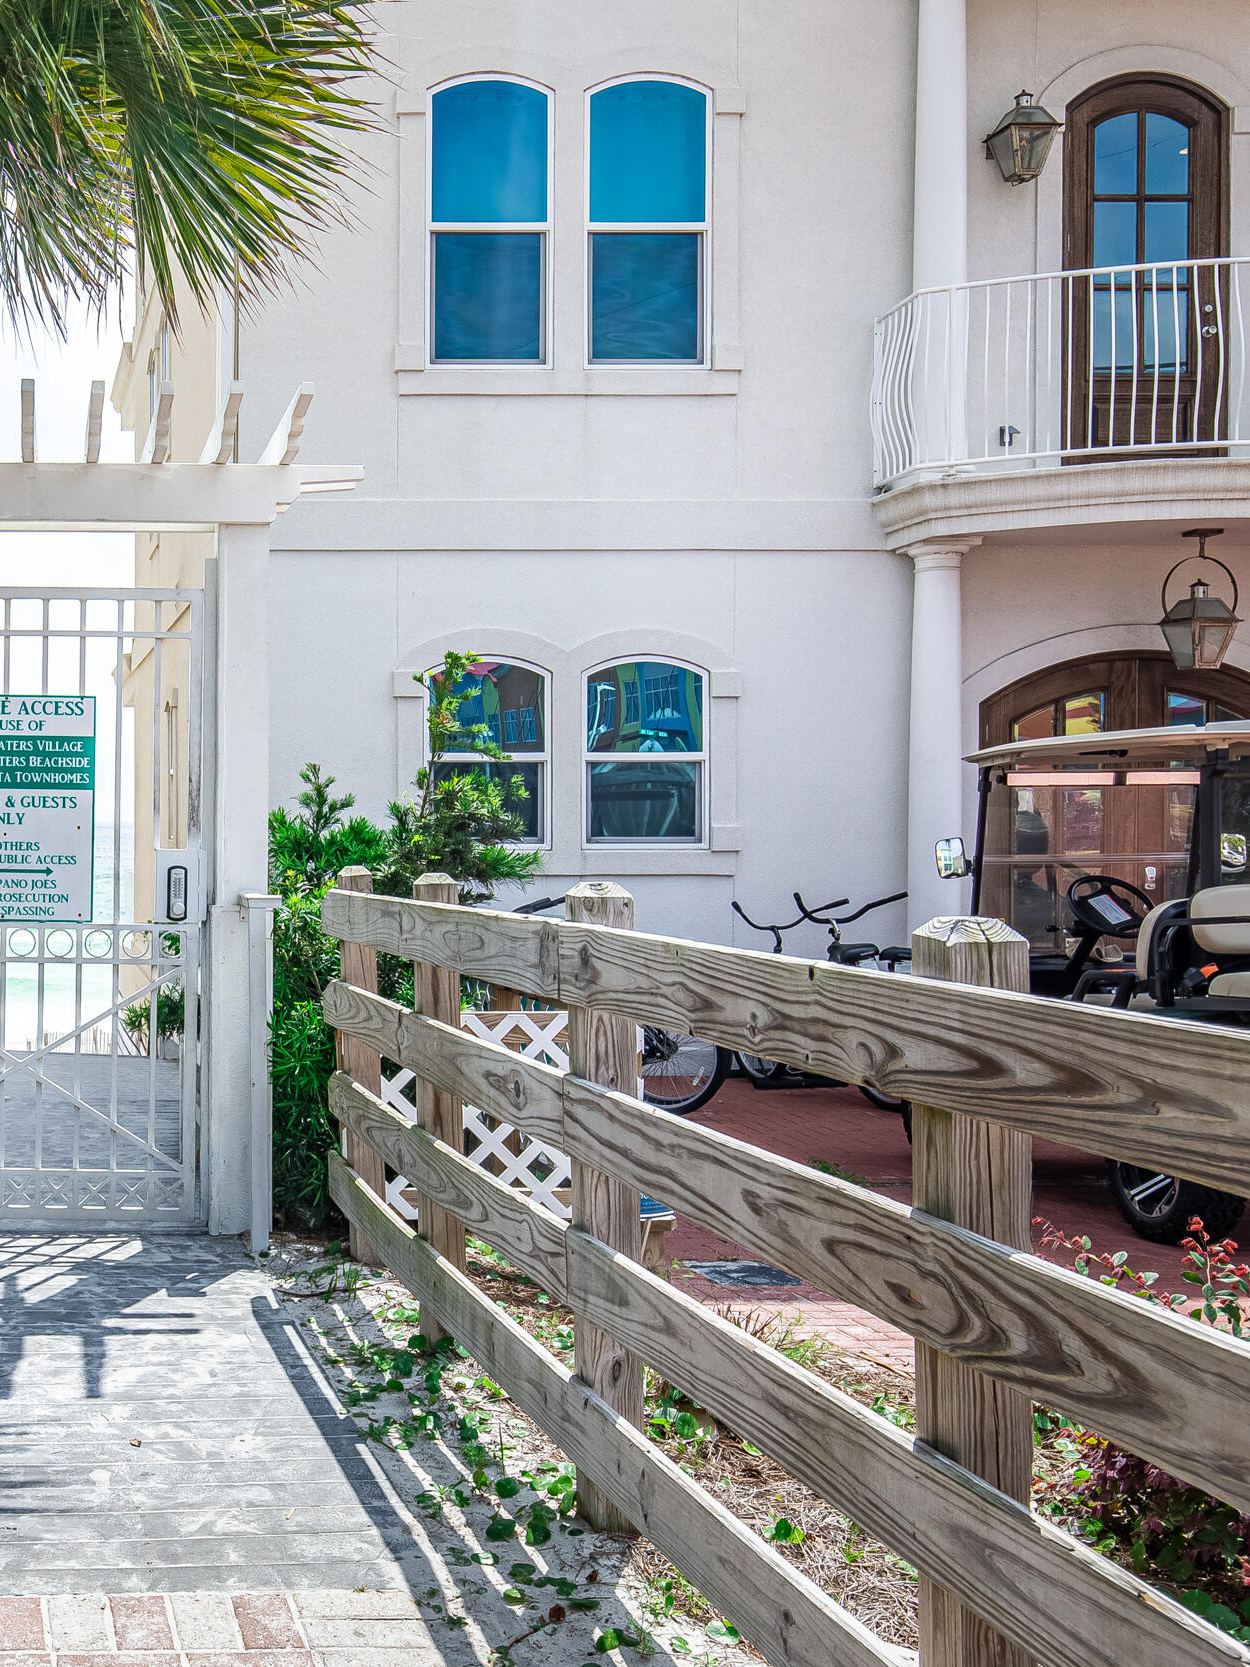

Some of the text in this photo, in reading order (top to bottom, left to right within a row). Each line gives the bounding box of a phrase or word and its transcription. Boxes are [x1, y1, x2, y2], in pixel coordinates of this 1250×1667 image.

[17, 701, 84, 716] ACCESS
[0, 720, 24, 730] USE
[28, 720, 46, 731] OF
[36, 741, 84, 752] VILLAGE
[29, 756, 90, 768] BEACHSIDE
[15, 772, 89, 784] TOWNHOMES
[5, 796, 16, 808] &
[20, 796, 77, 809] GUESTS
[35, 855, 77, 865] ACCESS
[31, 879, 57, 891] JOES
